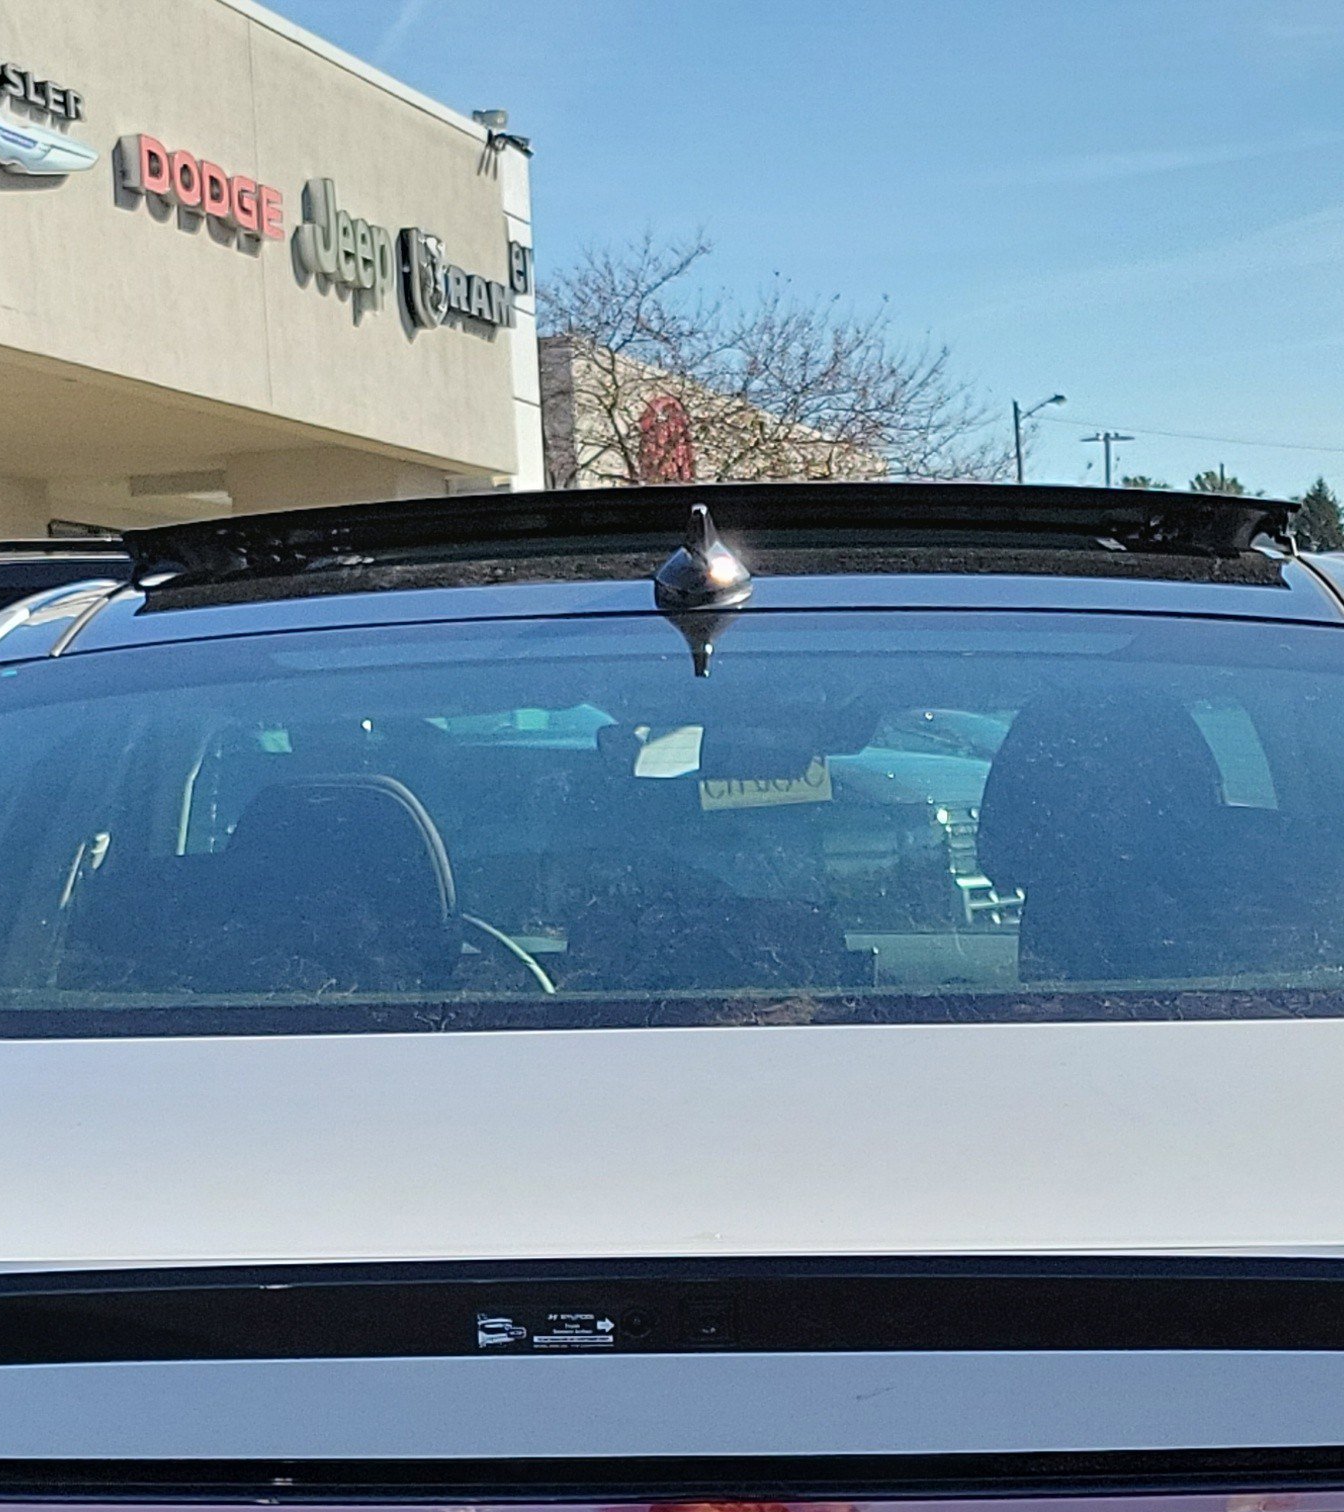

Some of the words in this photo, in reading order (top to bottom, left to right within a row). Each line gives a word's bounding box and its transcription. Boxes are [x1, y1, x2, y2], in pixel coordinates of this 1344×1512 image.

[136, 133, 285, 241] DODGE
[296, 178, 393, 310] Jeep
[445, 264, 516, 329] RAM
